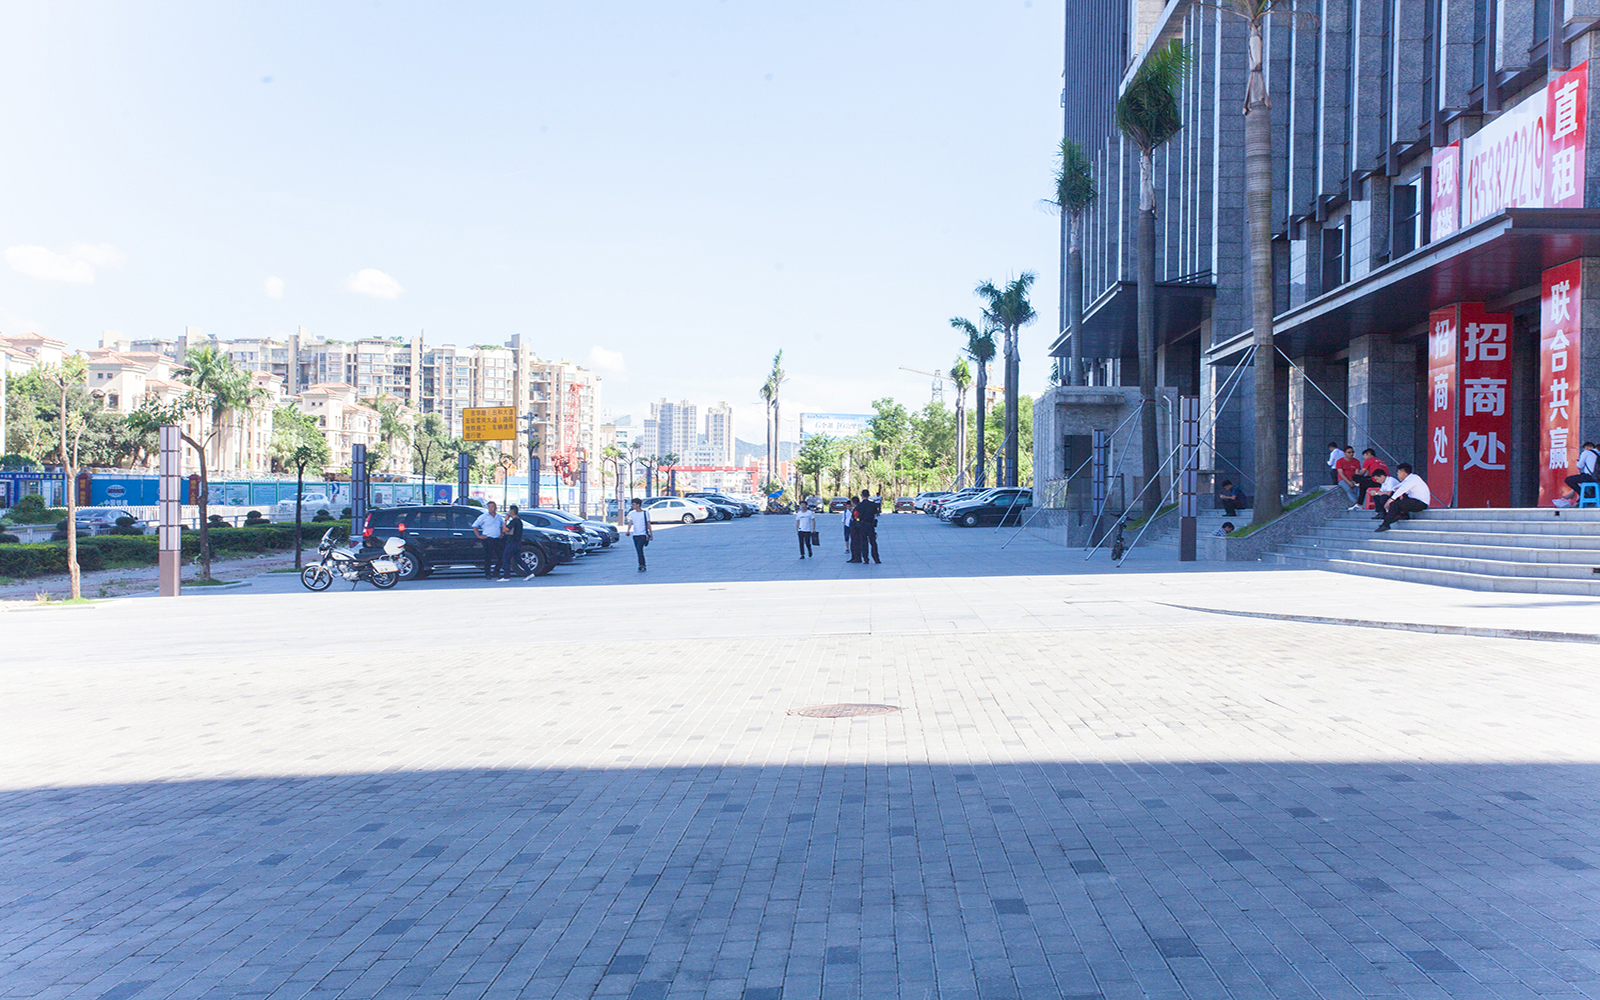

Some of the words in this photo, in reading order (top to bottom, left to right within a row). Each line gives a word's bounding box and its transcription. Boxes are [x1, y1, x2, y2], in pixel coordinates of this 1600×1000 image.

[1551, 79, 1579, 204] 直租
[1432, 319, 1449, 465] 招商处
[1463, 322, 1507, 470] 招商处
[1548, 280, 1570, 469] 联合共赢
